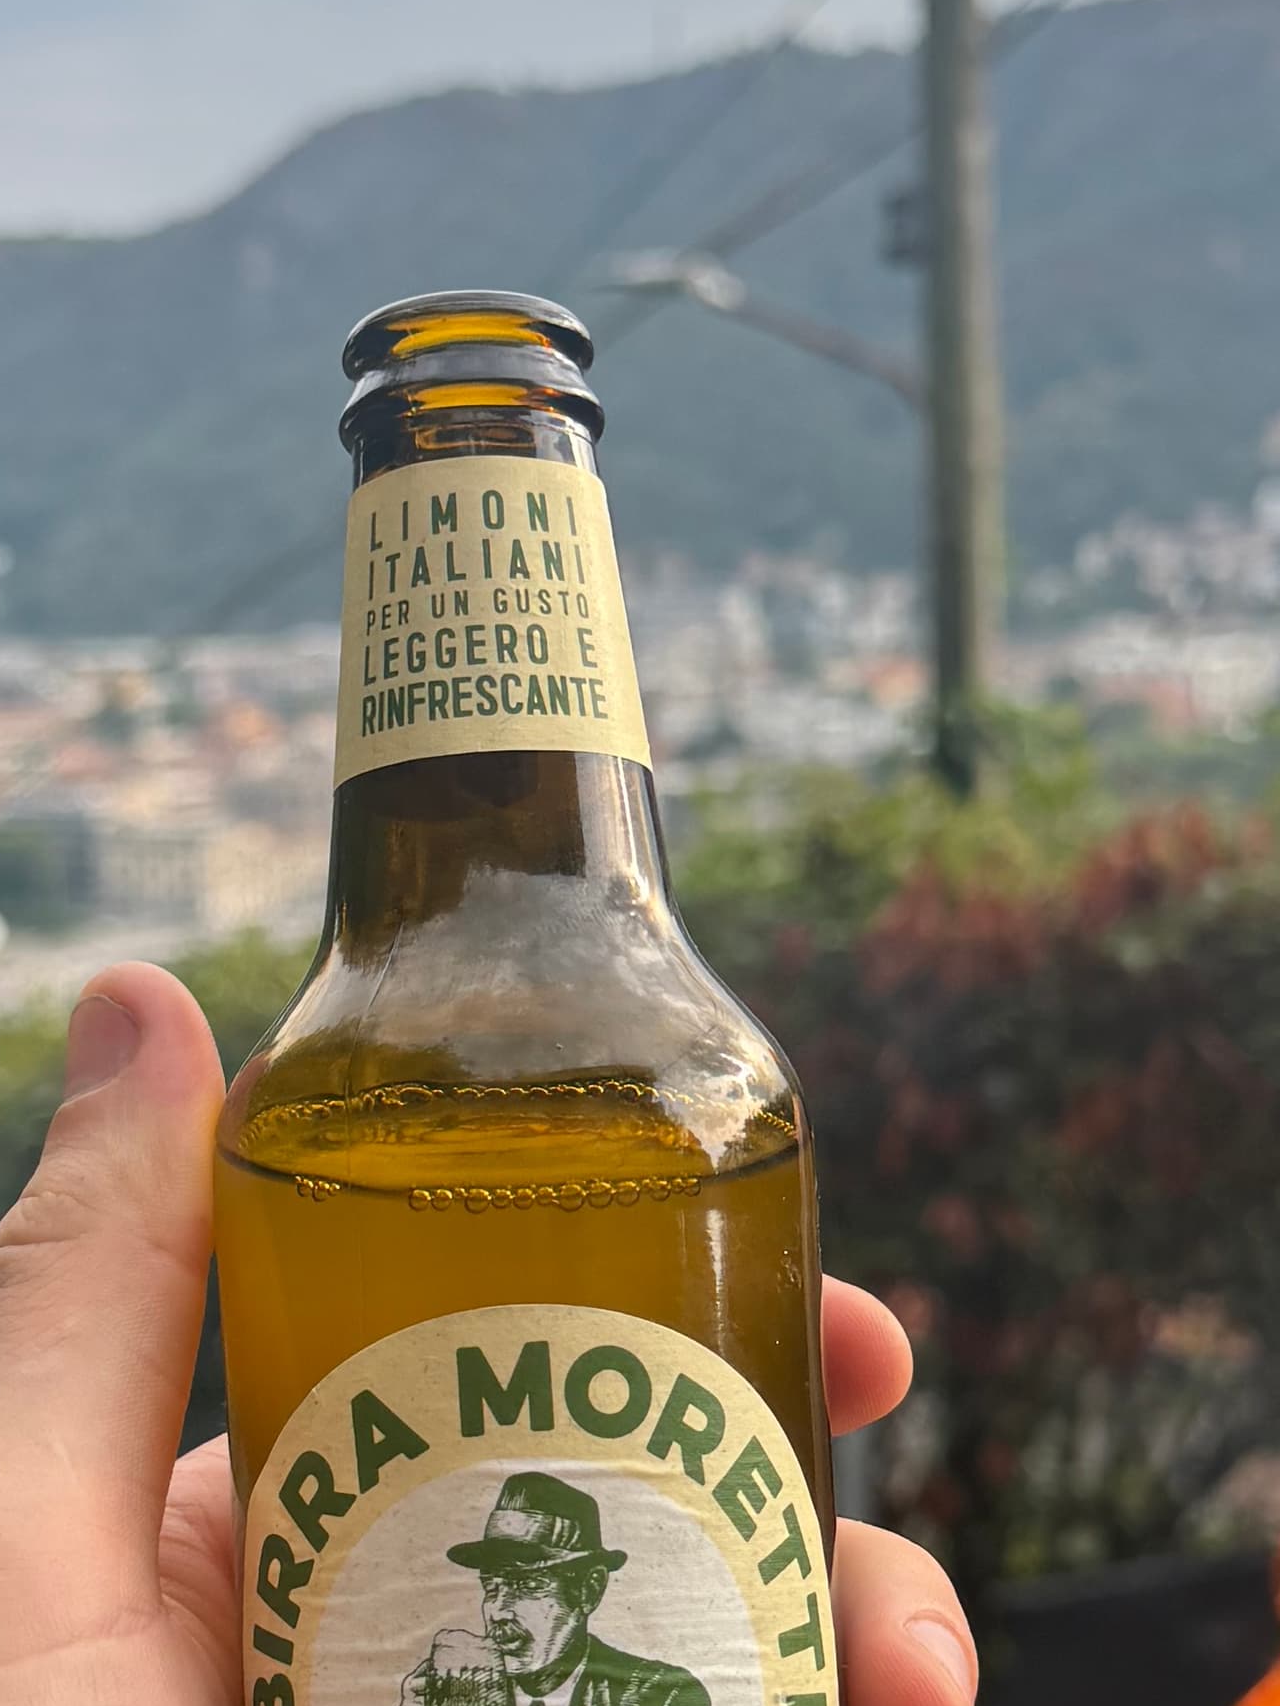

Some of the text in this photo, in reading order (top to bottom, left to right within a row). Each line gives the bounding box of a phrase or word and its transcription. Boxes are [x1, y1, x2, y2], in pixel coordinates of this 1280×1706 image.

[370, 489, 577, 551] LIMONI
[368, 539, 585, 601] ITALIANI
[367, 588, 589, 636] PER UN GUSTO
[363, 623, 598, 687] LEGGERO E
[361, 673, 608, 737] RINFRESCANTE
